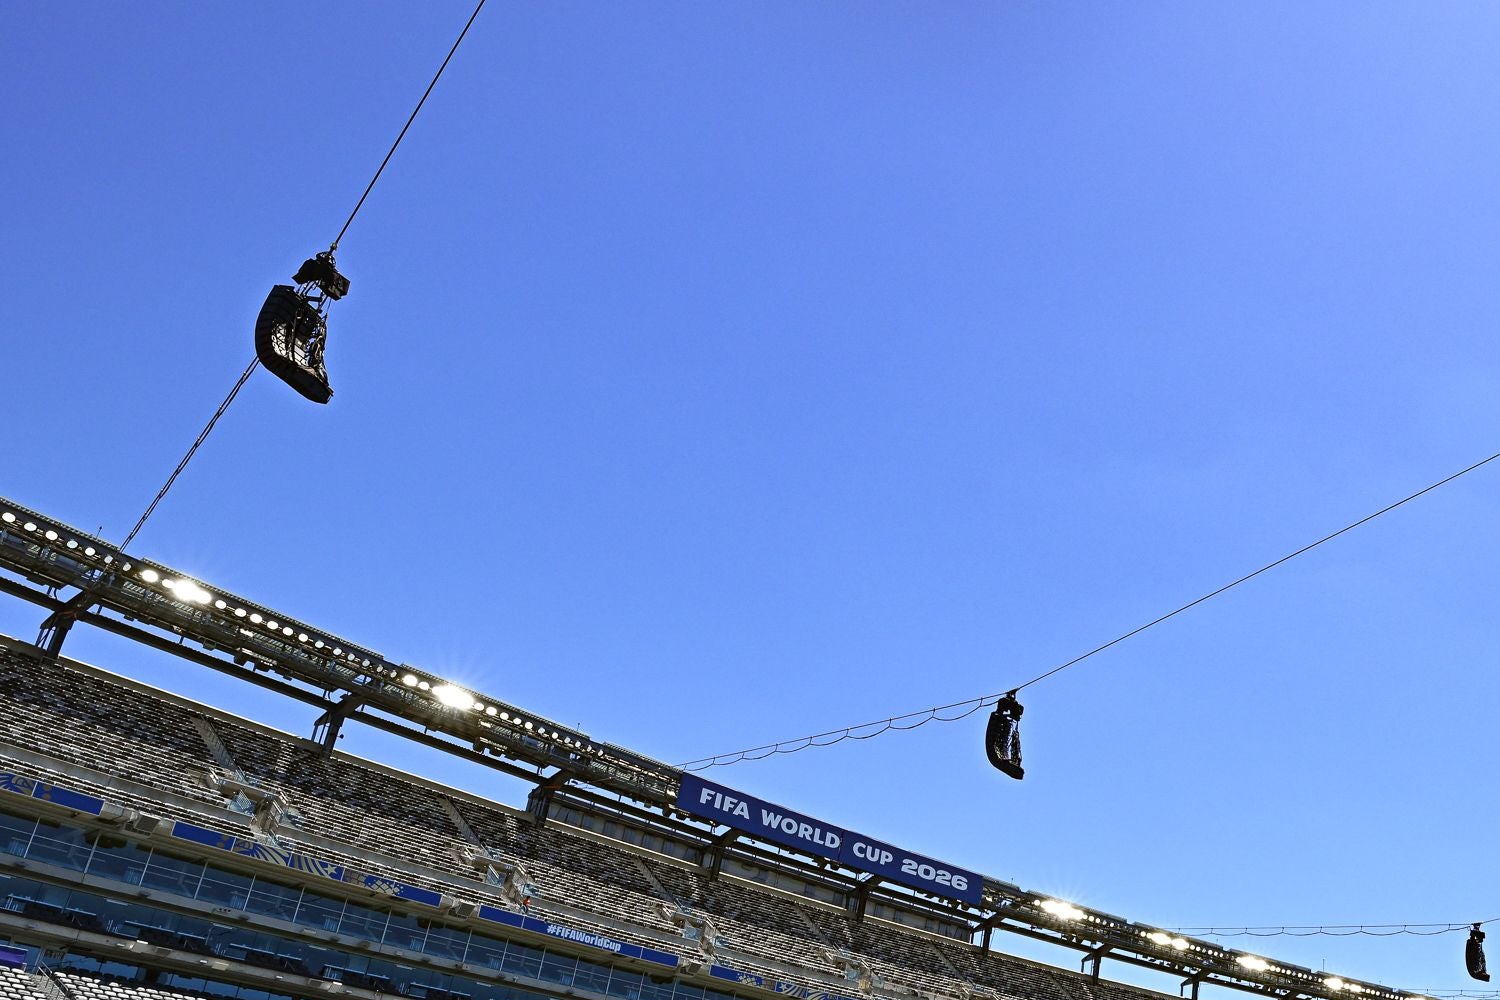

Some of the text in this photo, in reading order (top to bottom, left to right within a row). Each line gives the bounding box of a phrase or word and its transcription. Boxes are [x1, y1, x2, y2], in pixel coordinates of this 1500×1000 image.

[700, 787, 968, 891] FIFA WORLD CUP 2026
[547, 924, 621, 952] #FIFAWorldCup
